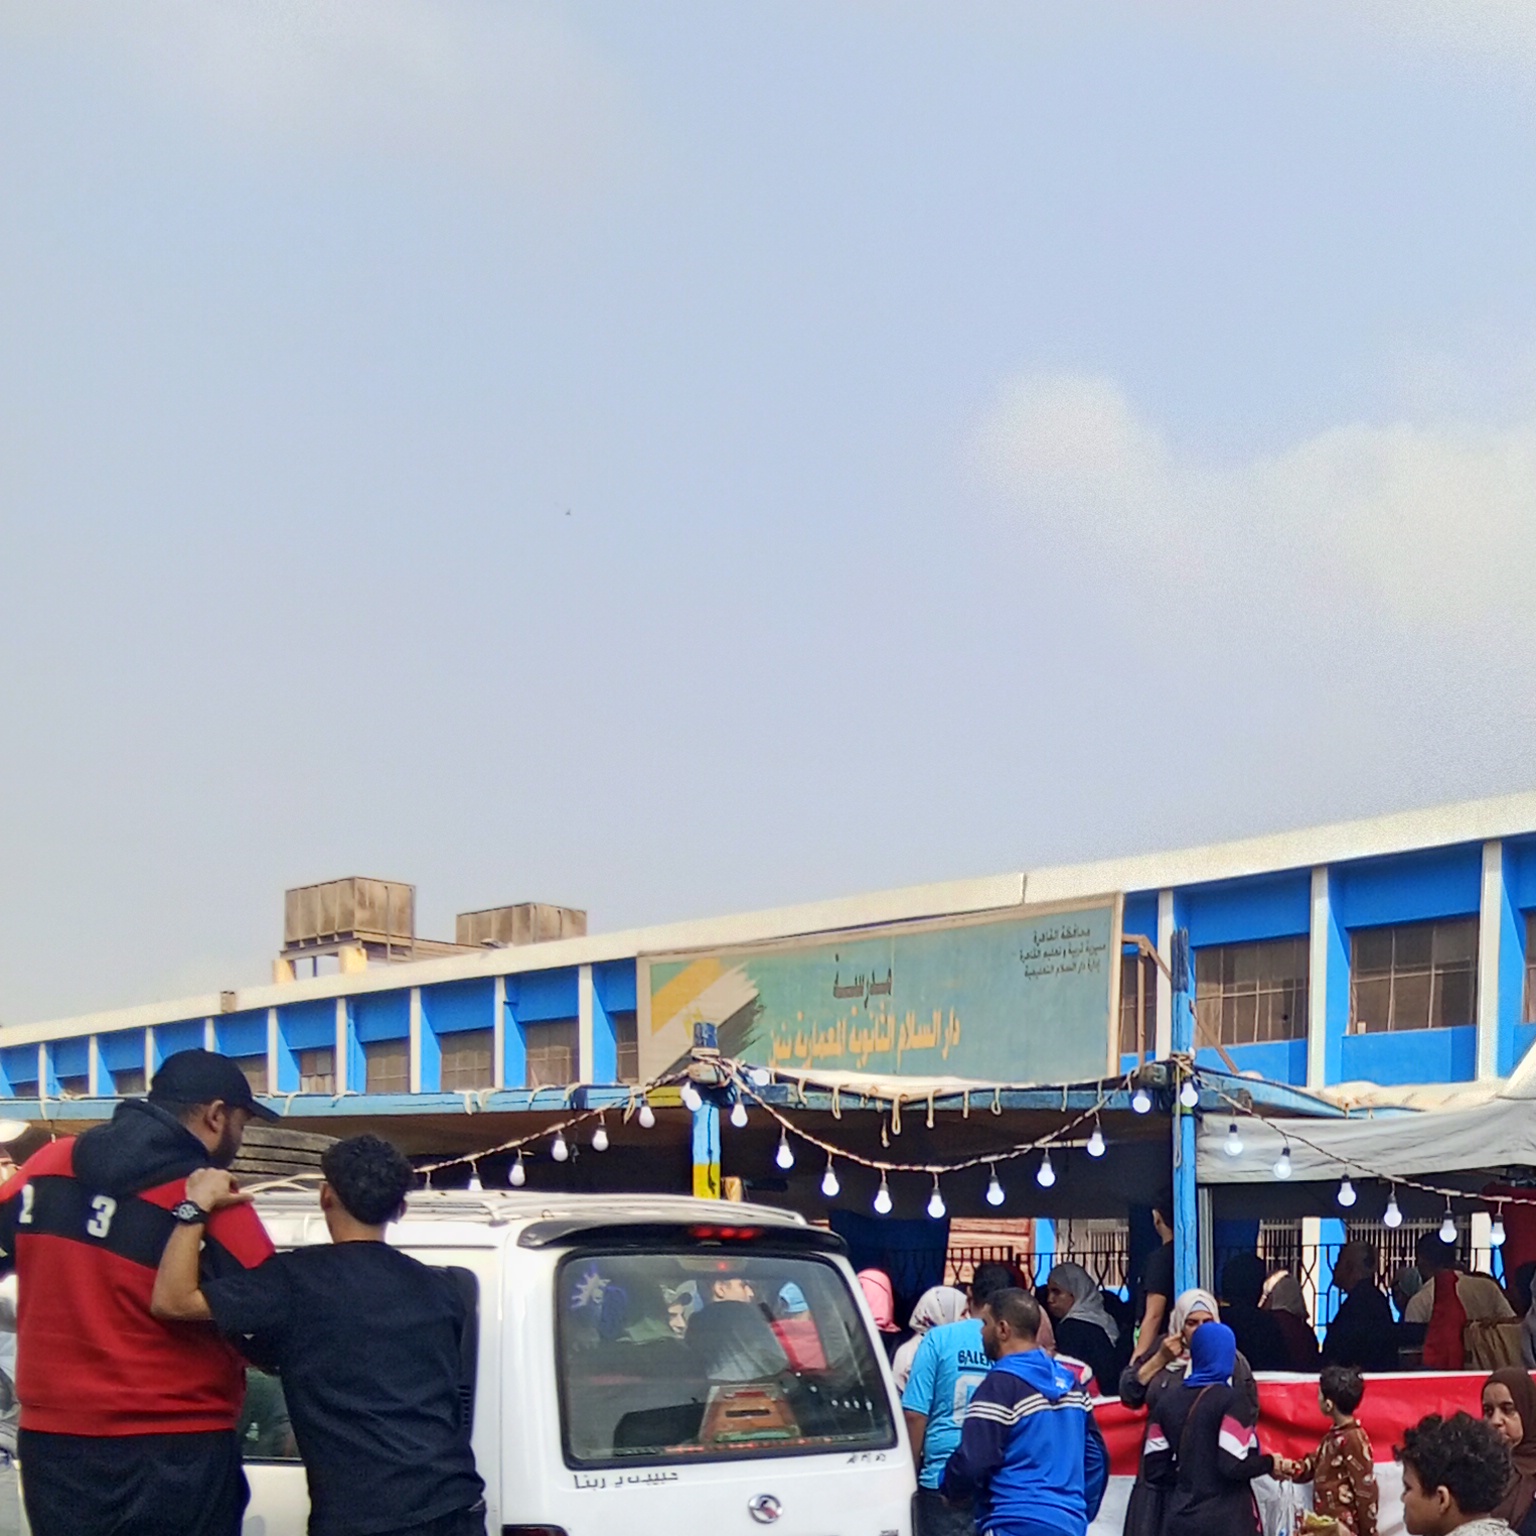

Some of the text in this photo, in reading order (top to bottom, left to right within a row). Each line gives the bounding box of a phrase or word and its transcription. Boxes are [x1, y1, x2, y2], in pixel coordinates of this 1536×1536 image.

[833, 953, 892, 1010] مدرسة
[849, 1000, 897, 1069] الثانوية
[897, 1009, 943, 1070] السلام
[941, 1006, 961, 1061] دار
[86, 1194, 118, 1238] 3
[573, 1474, 606, 1491] ربنا
